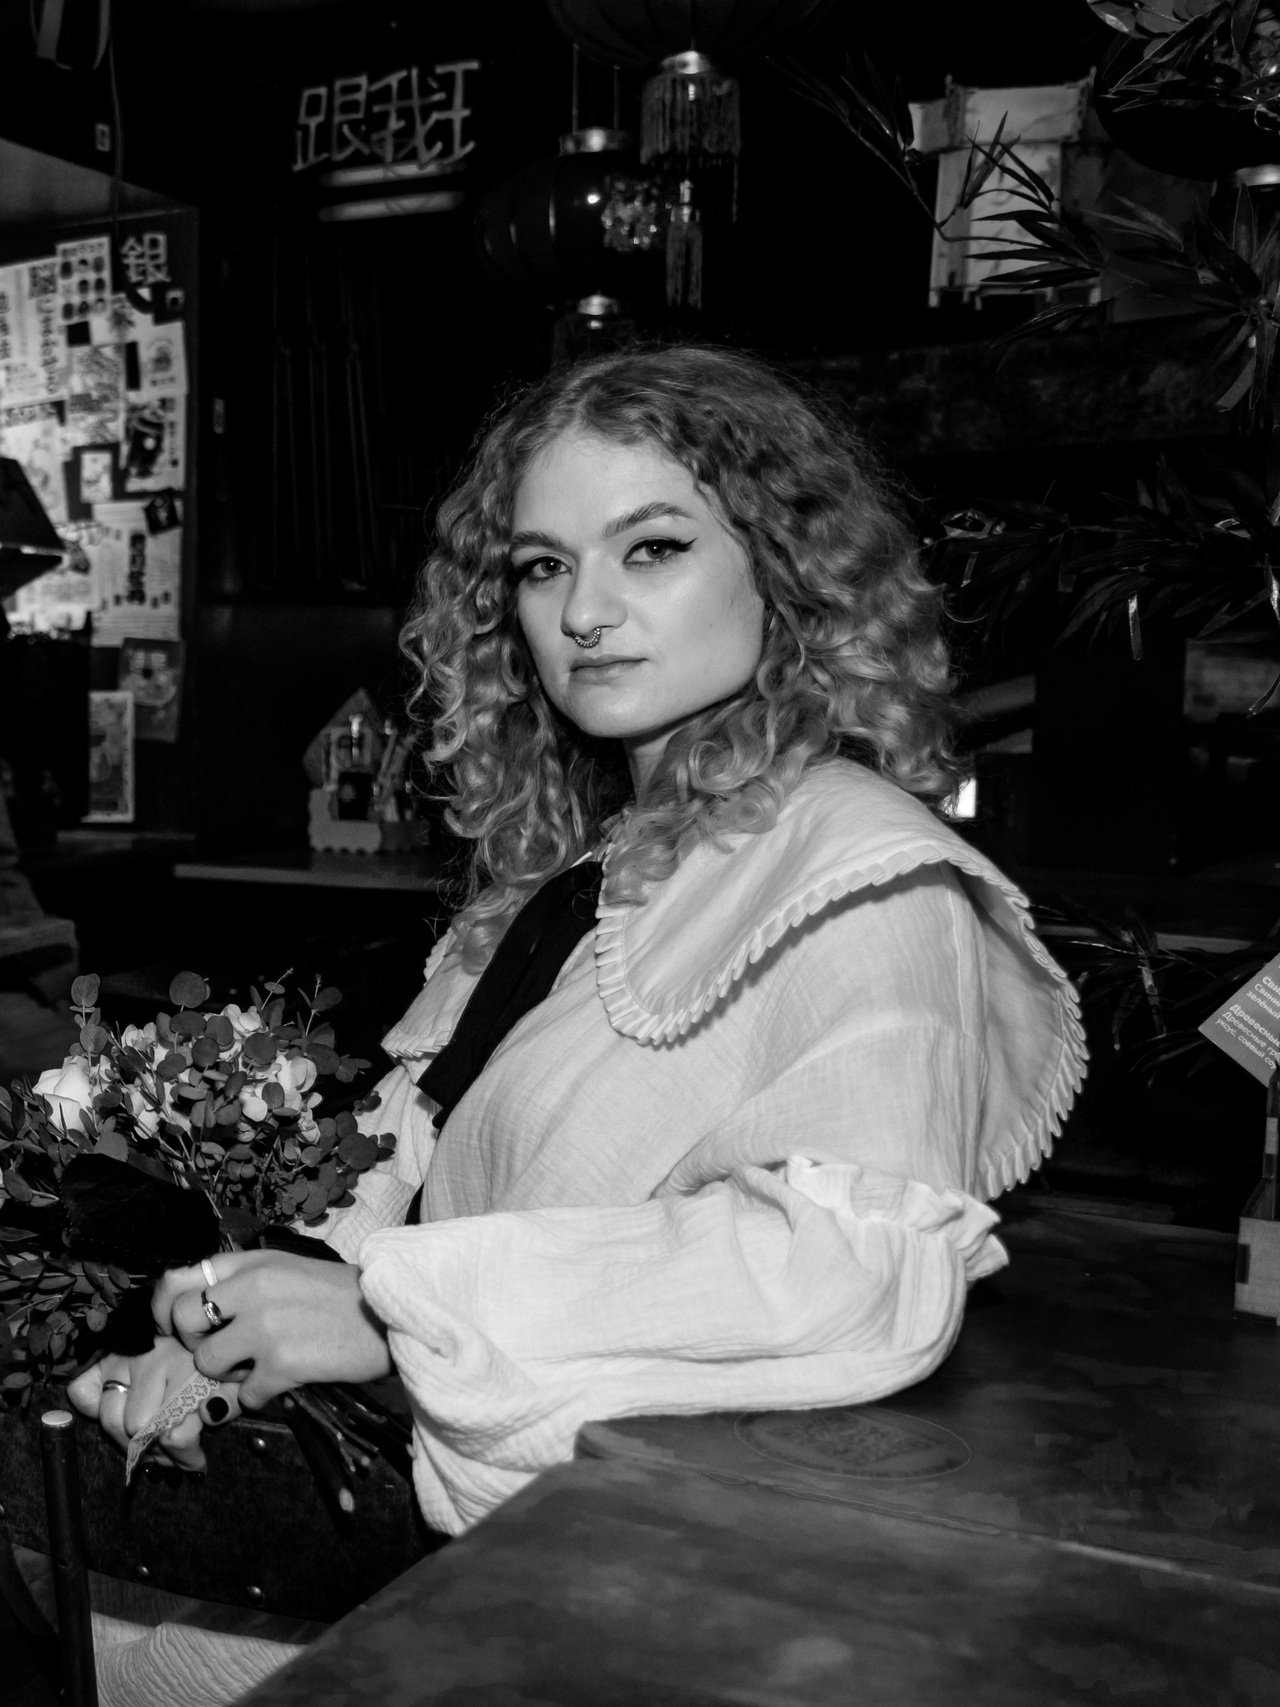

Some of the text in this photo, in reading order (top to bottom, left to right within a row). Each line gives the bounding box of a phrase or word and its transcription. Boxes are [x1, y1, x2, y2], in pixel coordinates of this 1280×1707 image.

[1255, 983, 1280, 1007] Свини
[1262, 976, 1280, 996] Сви
[1222, 1011, 1267, 1048] Древесные
[1237, 1035, 1265, 1058] соевый
[1264, 1057, 1276, 1069] соу
